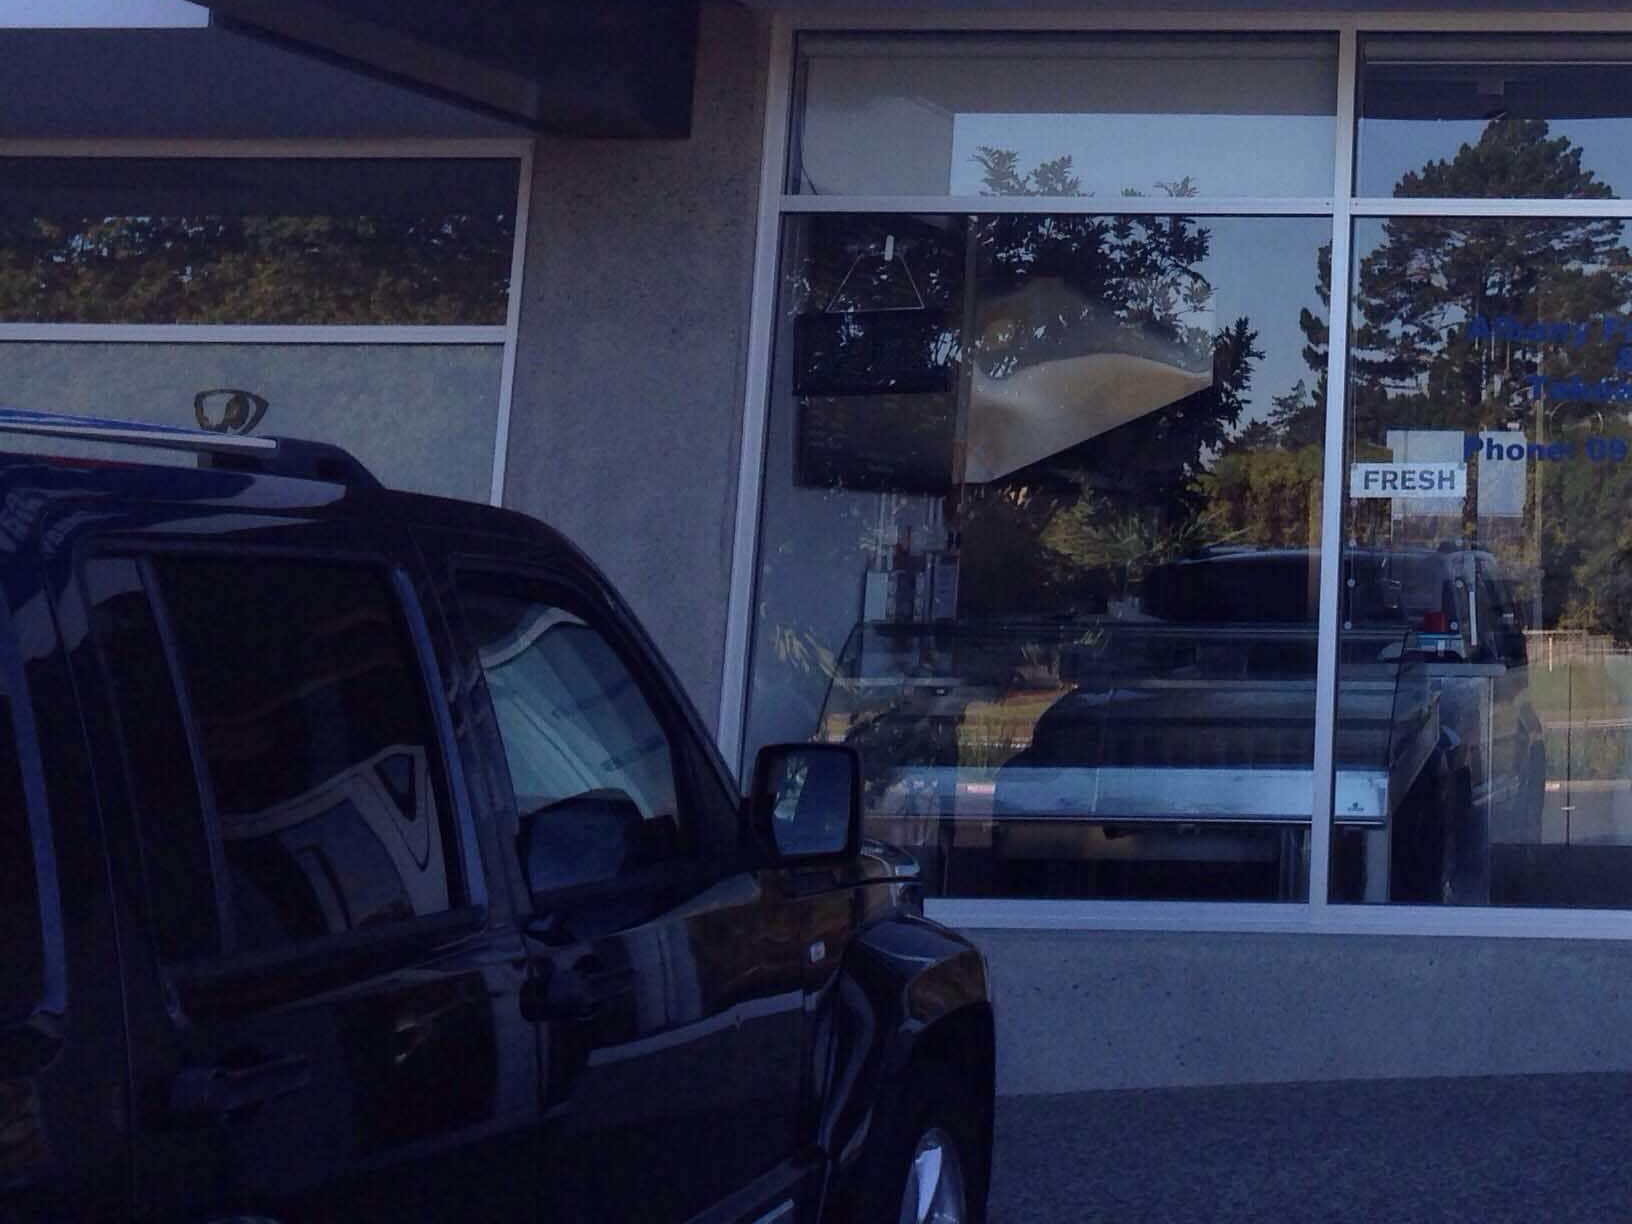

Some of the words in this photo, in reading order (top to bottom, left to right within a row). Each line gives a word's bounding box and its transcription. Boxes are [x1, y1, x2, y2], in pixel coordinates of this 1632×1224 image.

[1466, 316, 1589, 350] Albany
[1585, 436, 1629, 463] 09
[1363, 469, 1456, 490] FRESH
